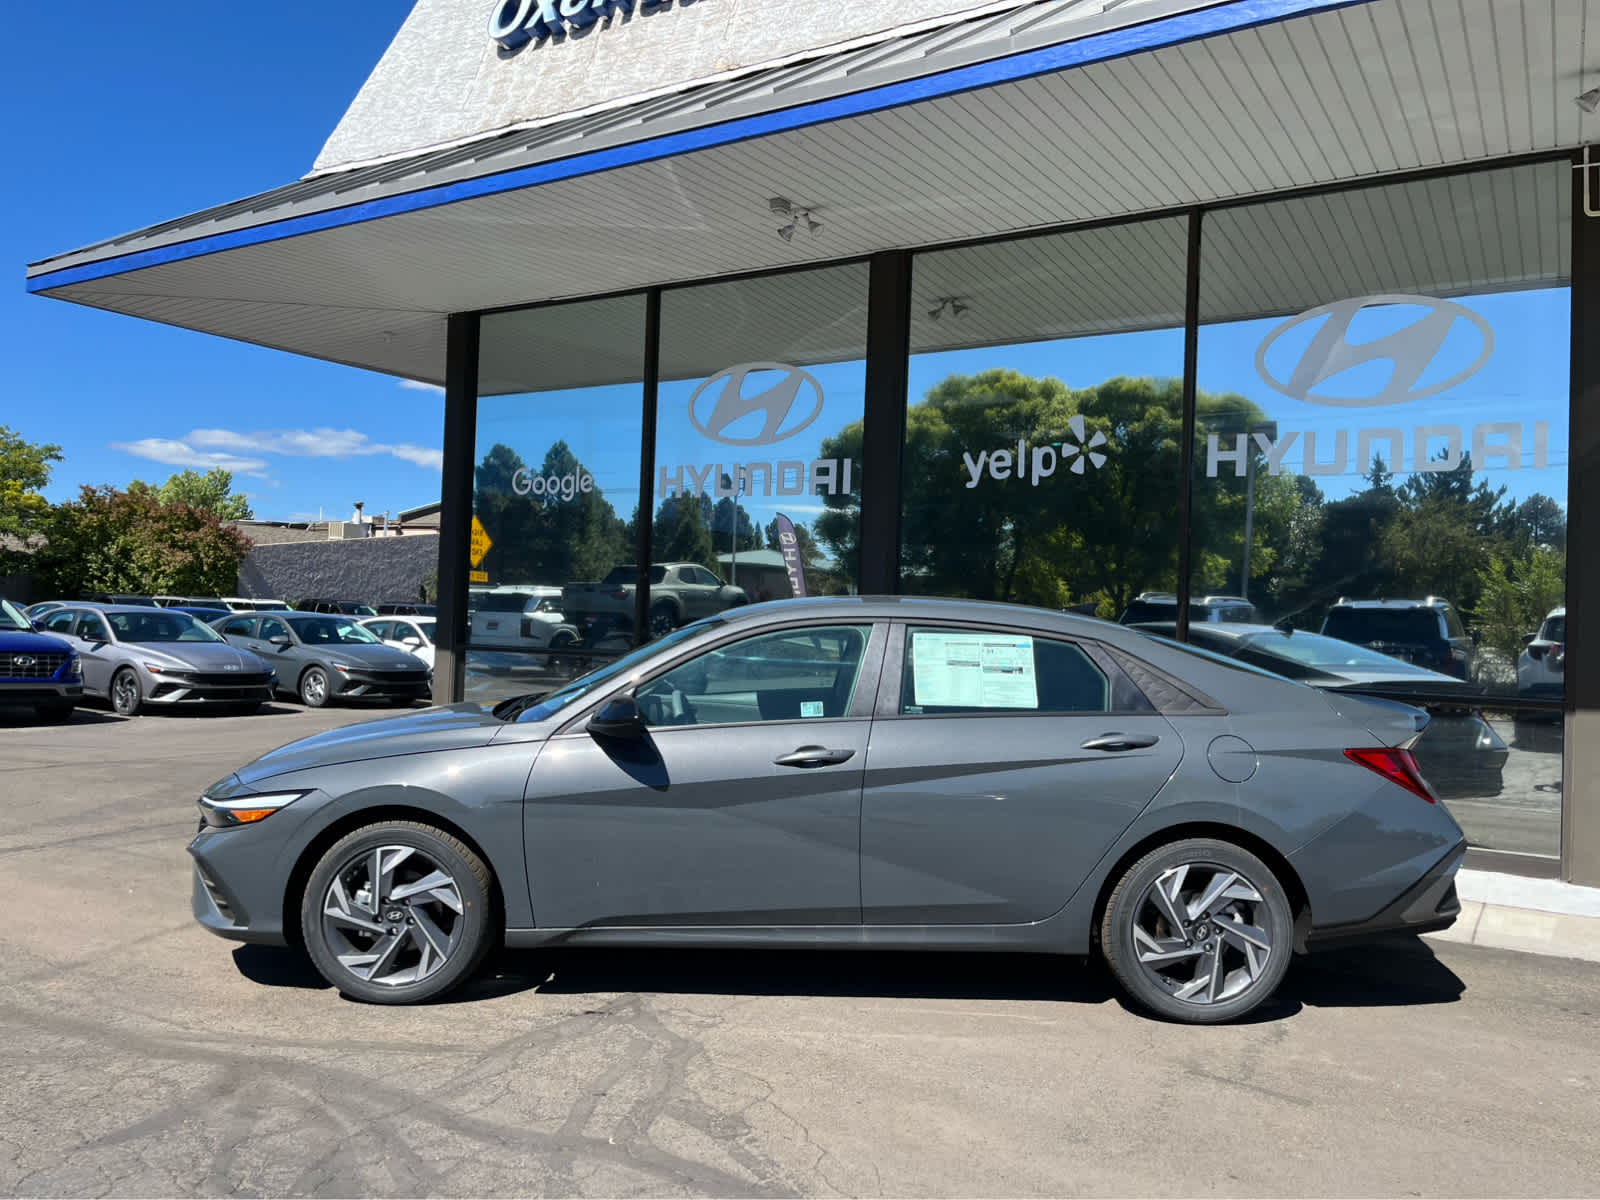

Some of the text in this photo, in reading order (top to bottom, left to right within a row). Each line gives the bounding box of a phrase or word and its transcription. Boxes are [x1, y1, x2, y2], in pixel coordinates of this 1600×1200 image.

[962, 439, 1057, 488] yelp
[1206, 420, 1549, 478] HYUNDAI
[511, 465, 593, 502] Google
[658, 457, 852, 499] HYUNDAI
